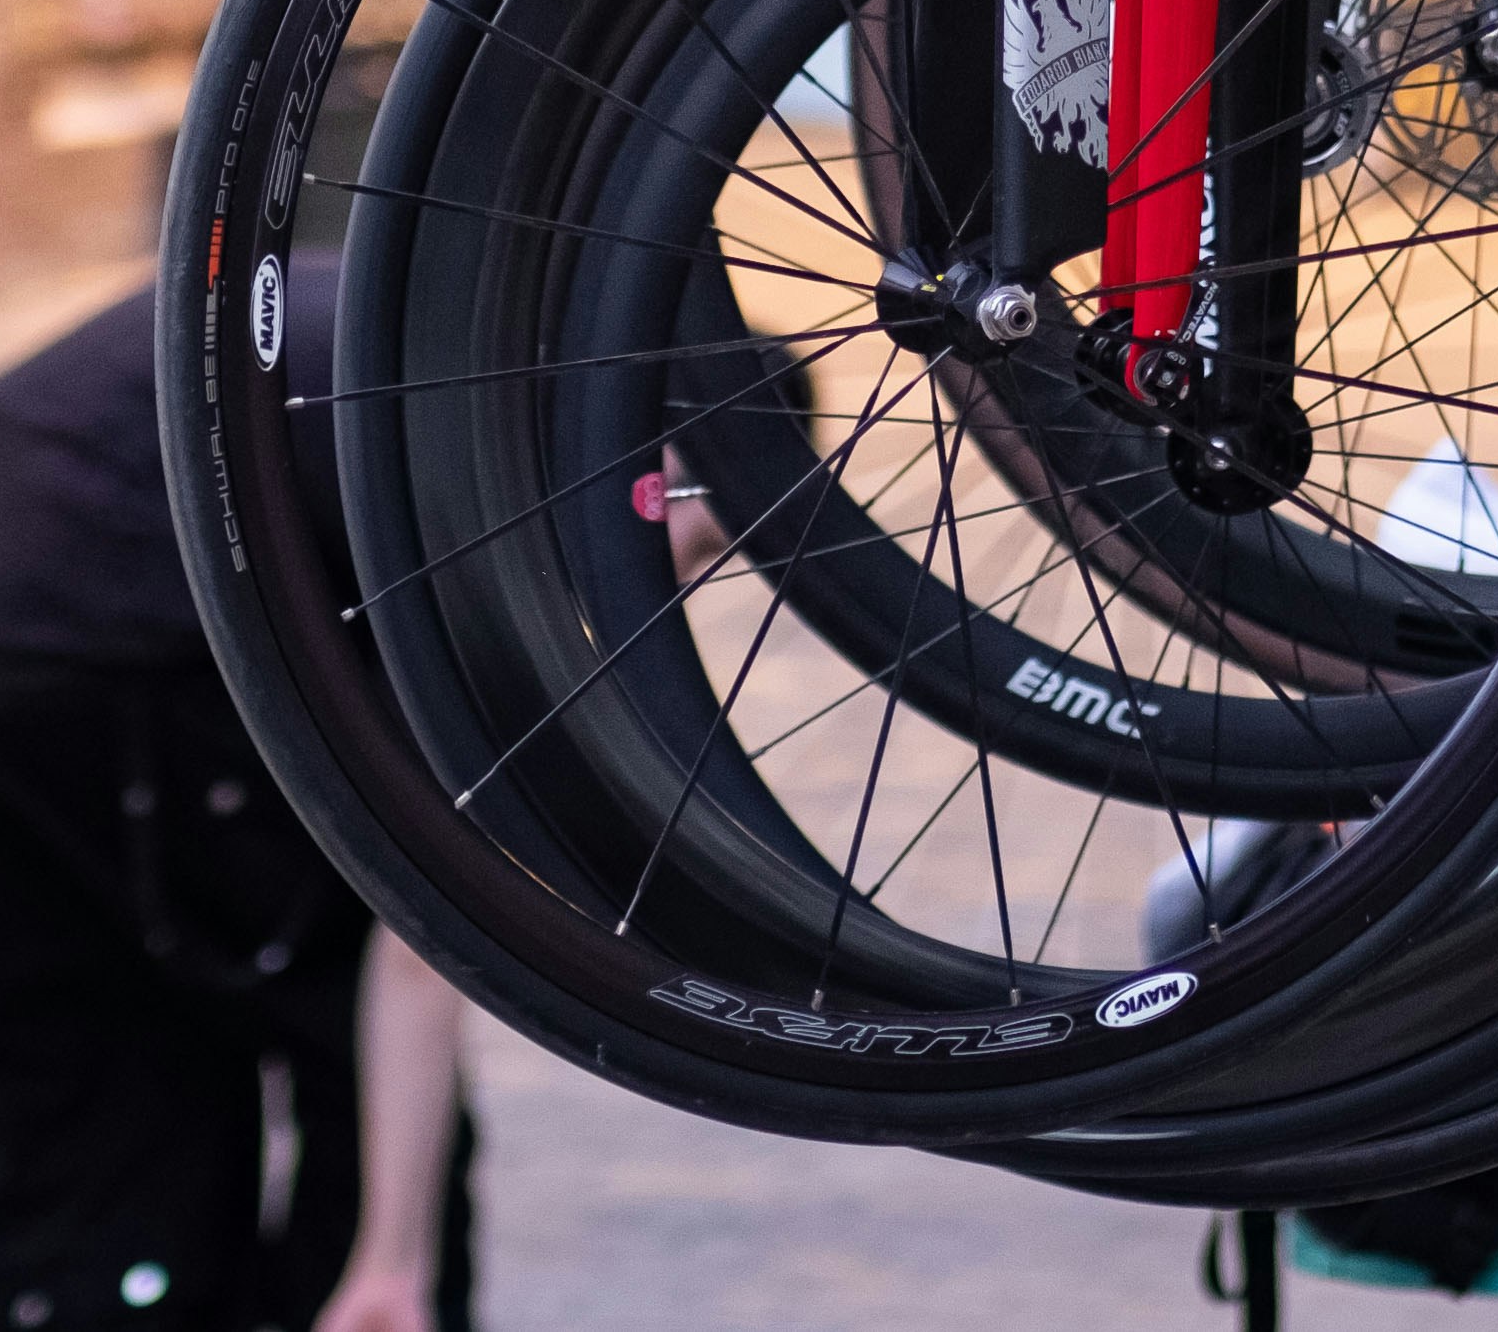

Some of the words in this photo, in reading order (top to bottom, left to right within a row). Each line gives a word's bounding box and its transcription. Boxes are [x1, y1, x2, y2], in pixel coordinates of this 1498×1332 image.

[214, 141, 238, 214] PRO
[232, 58, 263, 132] ONE
[256, 271, 278, 354] MAVIC
[1177, 280, 1220, 345] NOVATEC
[205, 346, 247, 574] SCHWALBE
[1005, 656, 1162, 739] BMC
[1114, 978, 1181, 1019] MAVIC
